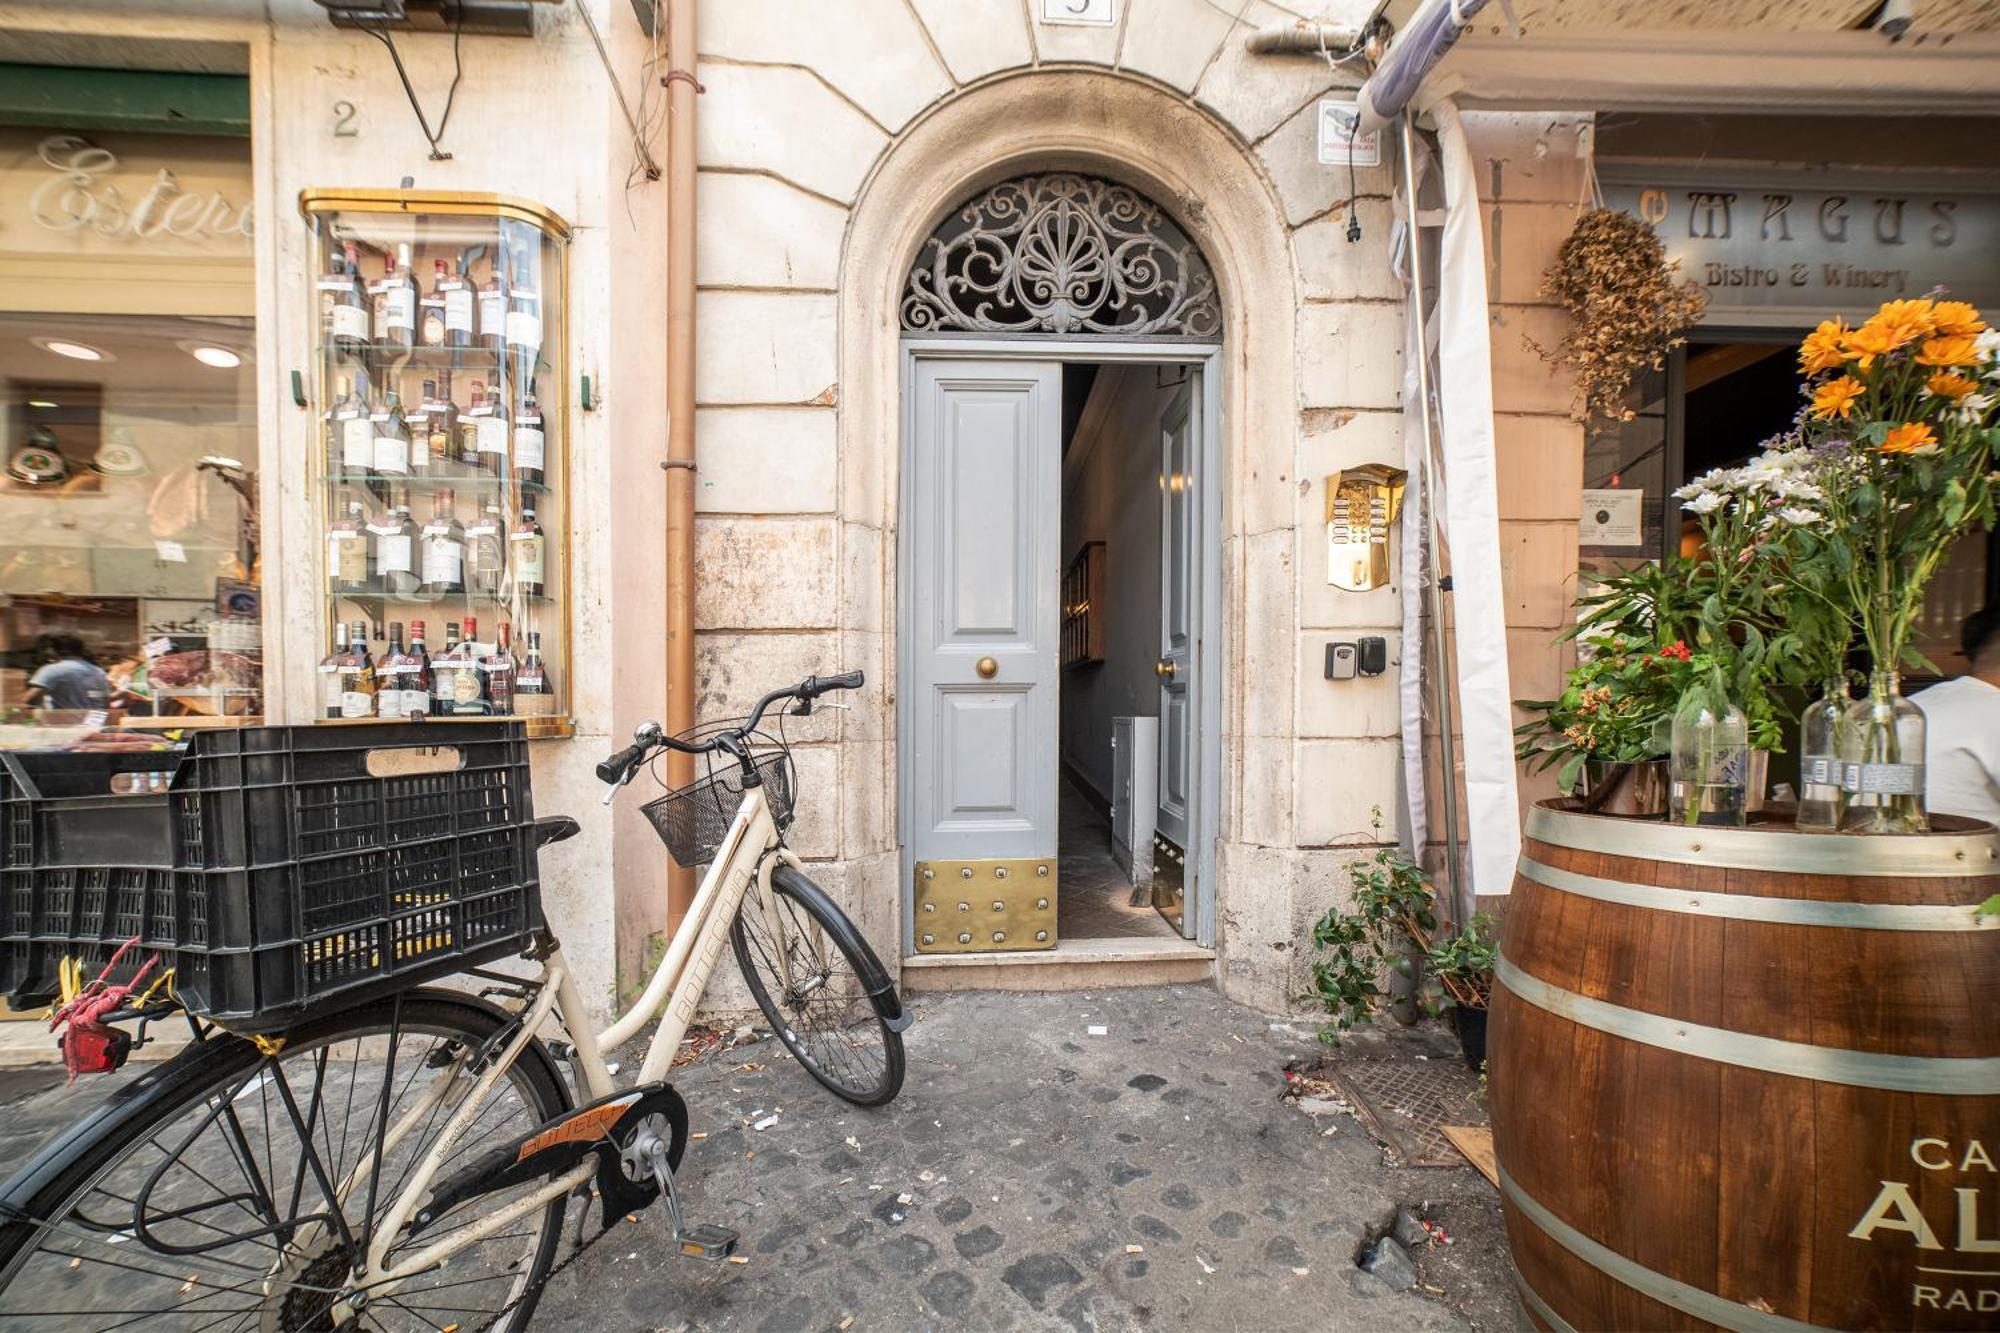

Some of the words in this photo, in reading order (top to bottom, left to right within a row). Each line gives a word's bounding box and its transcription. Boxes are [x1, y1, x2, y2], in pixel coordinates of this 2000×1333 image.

[333, 100, 359, 137] 2
[1686, 191, 1960, 247] MAGUS
[1704, 262, 1779, 288] Bistro
[1790, 262, 1810, 288] &
[1822, 262, 1910, 292] Winery
[674, 868, 750, 1024] BOTTECCHIA
[1910, 1137, 1999, 1173] CA
[1847, 1180, 2000, 1254] AL
[1911, 1283, 2000, 1313] RAD
